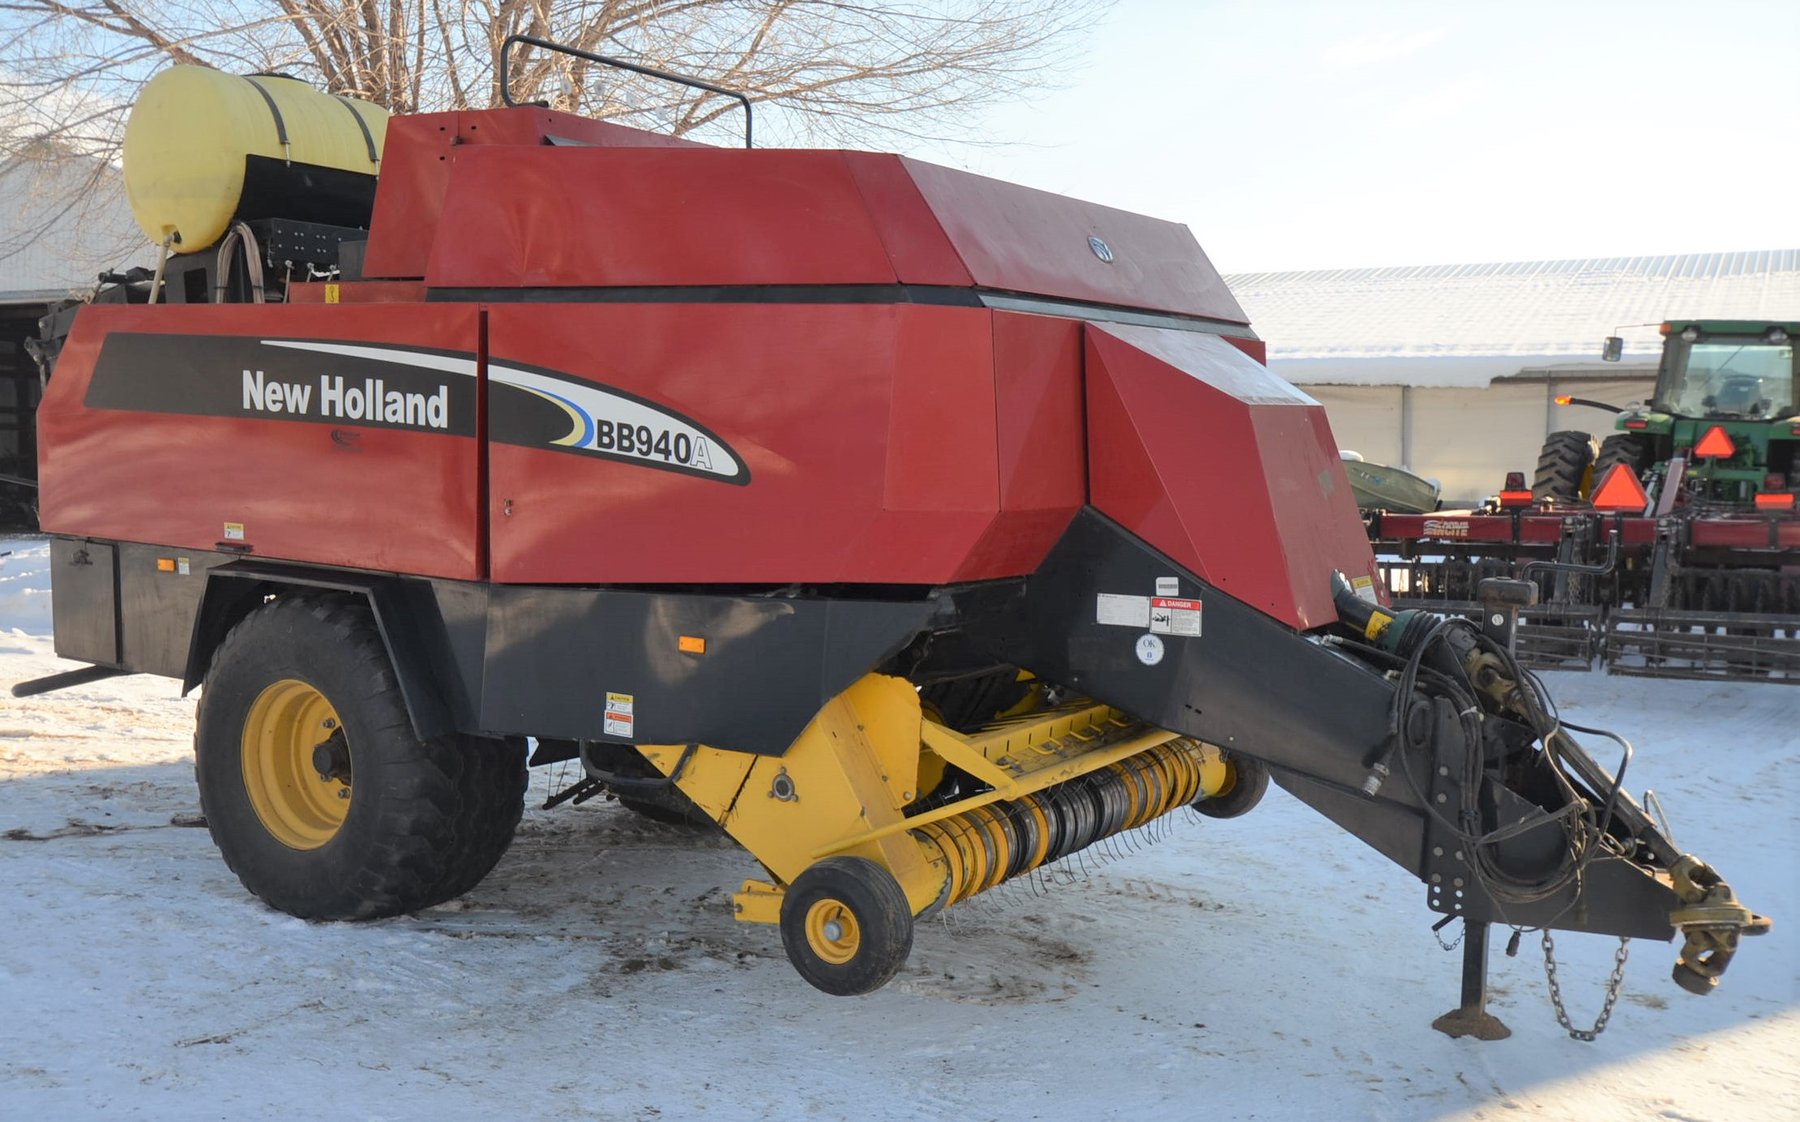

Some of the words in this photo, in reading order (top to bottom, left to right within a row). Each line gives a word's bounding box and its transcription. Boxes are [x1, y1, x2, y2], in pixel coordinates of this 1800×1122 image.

[242, 369, 312, 415] New
[320, 374, 448, 429] Holland
[596, 418, 713, 470] BB940A
[1167, 600, 1192, 609] DANGER
[1142, 638, 1157, 649] OK
